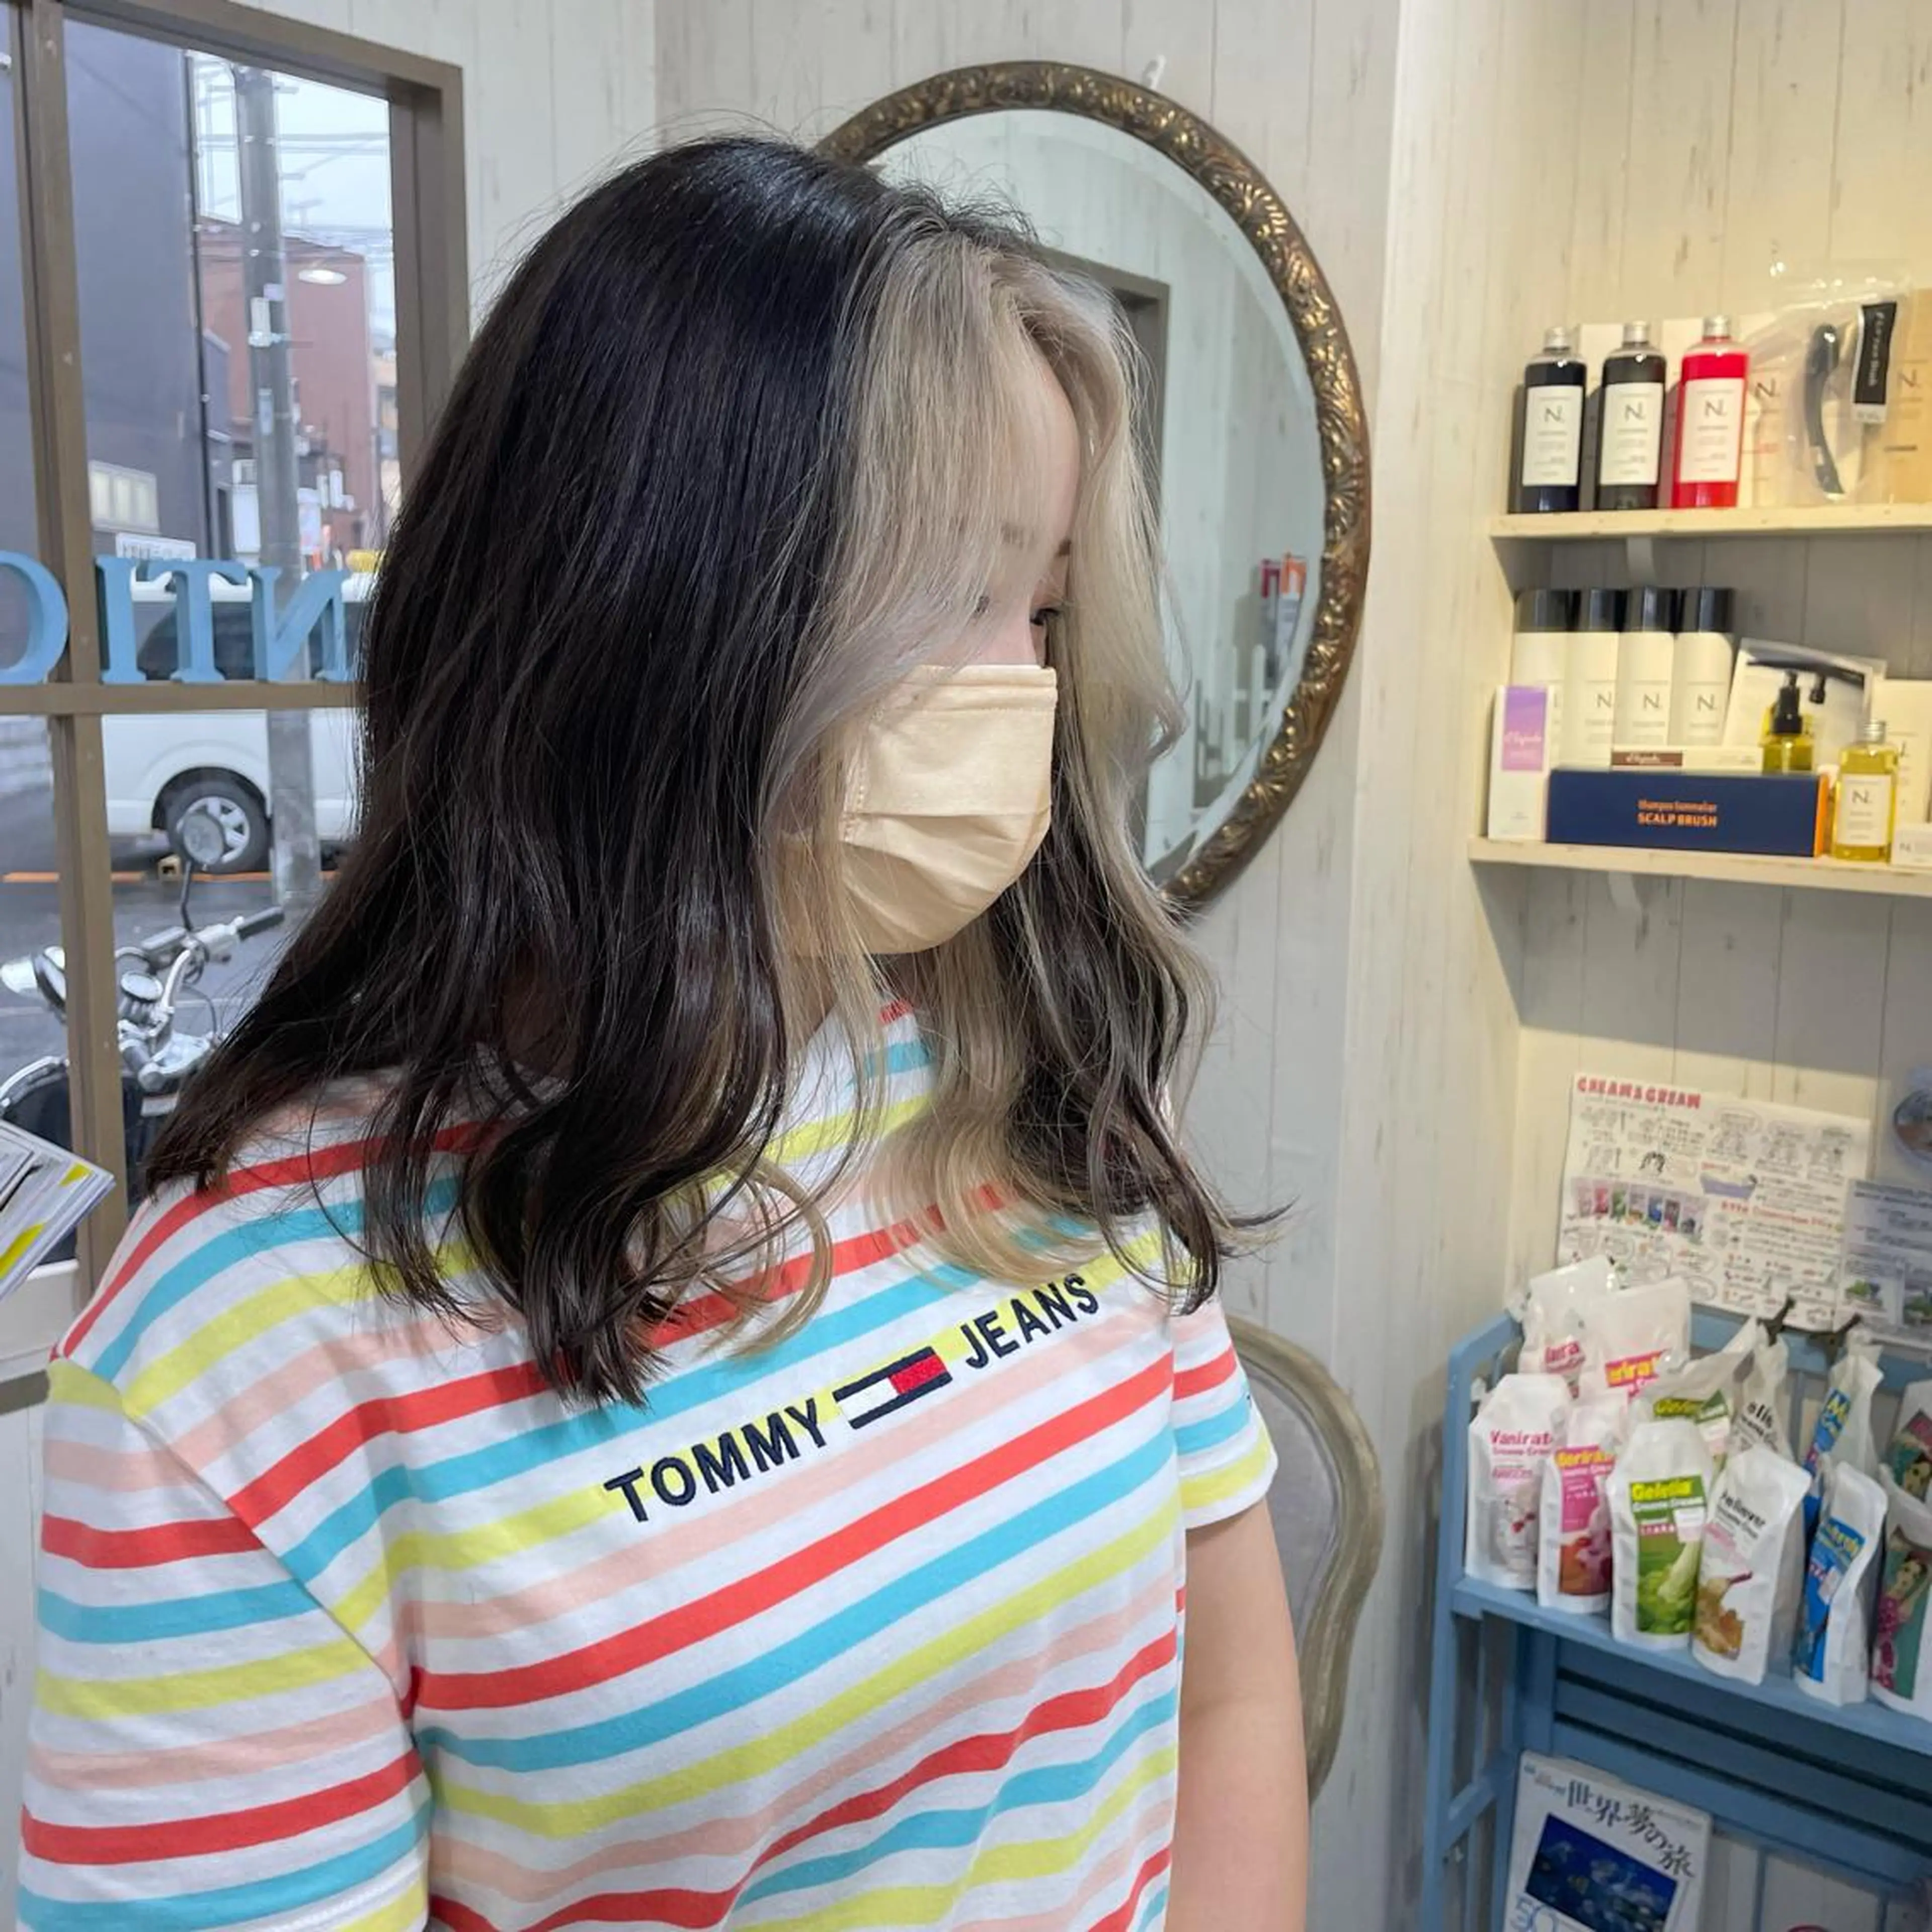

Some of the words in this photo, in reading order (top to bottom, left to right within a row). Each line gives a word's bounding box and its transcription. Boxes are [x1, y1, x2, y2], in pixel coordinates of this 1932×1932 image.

[1638, 812, 1676, 825] SCALP
[1677, 814, 1718, 828] BRUSH
[603, 1397, 827, 1522] TOMMY
[959, 1273, 1100, 1369] JEANS
